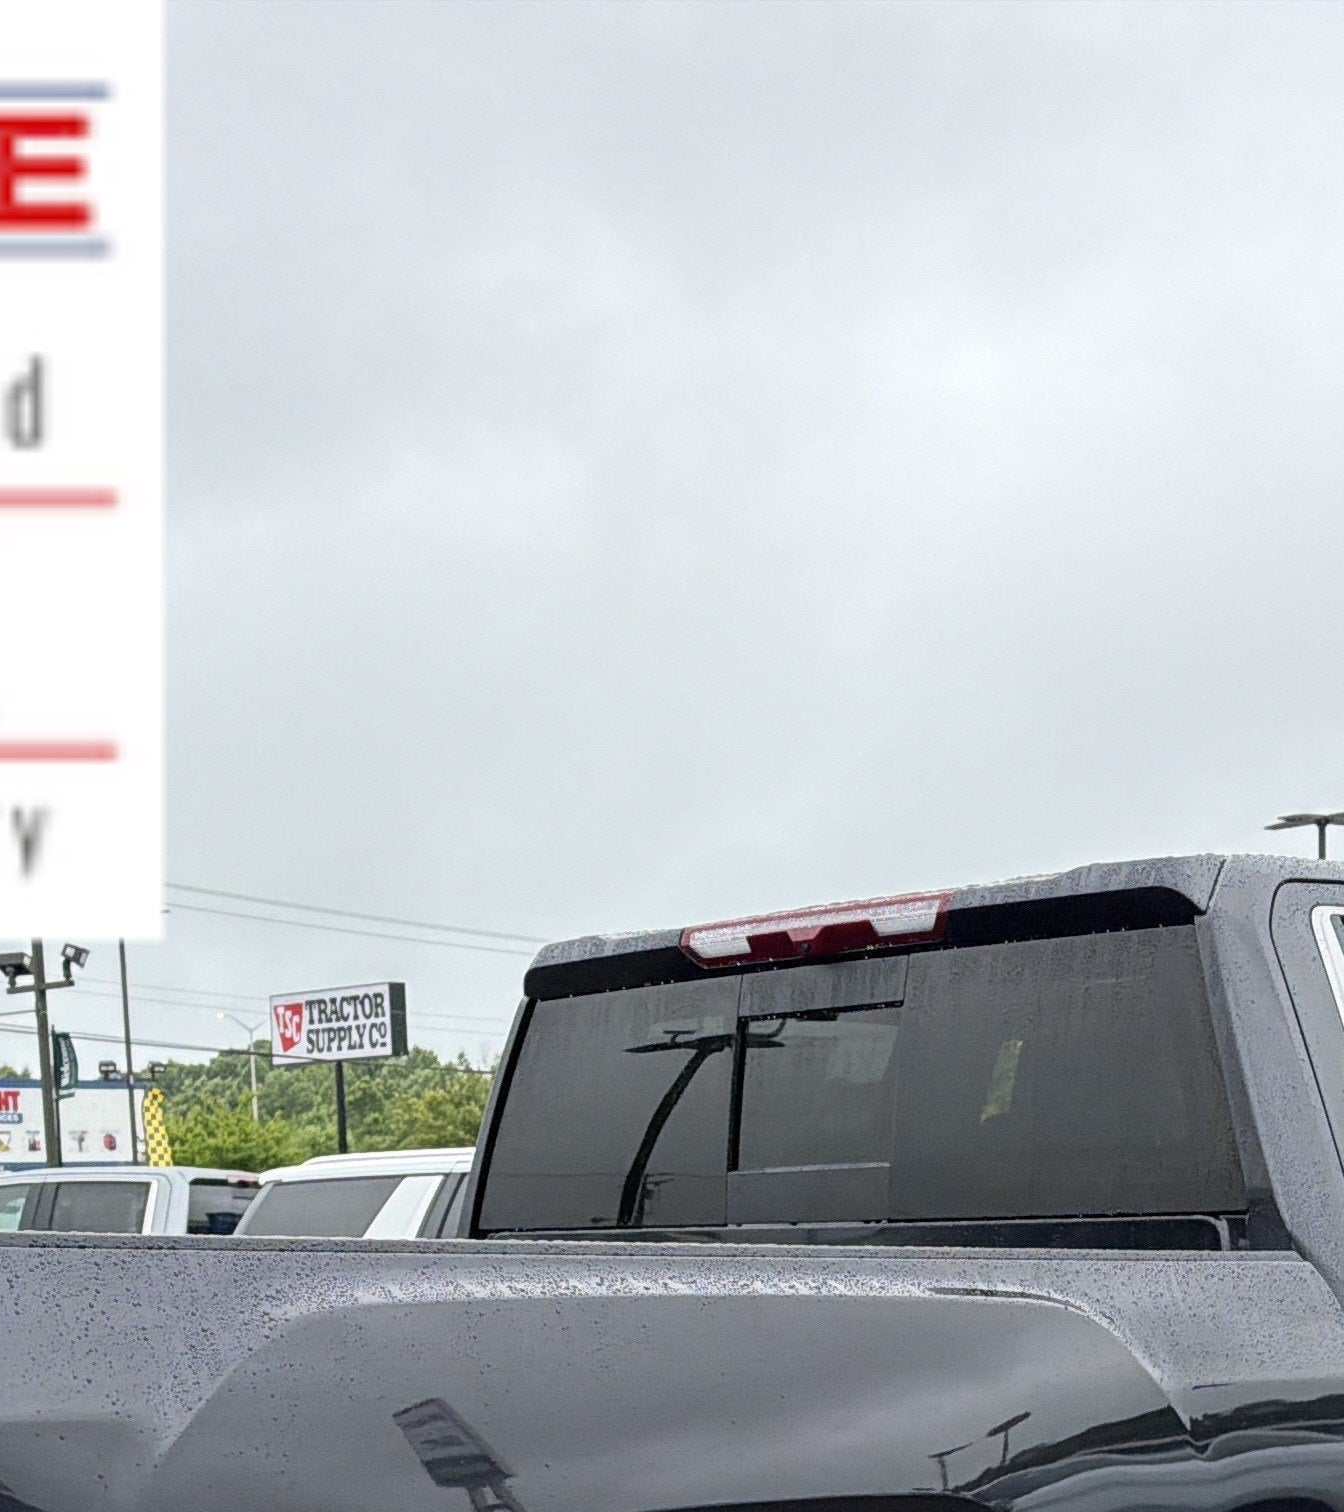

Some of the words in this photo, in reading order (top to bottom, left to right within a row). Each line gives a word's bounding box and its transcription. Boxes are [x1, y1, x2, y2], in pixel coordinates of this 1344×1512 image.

[276, 1006, 300, 1043] TSC
[306, 992, 386, 1025] TRACTOR
[306, 1022, 367, 1054] SUPPLY
